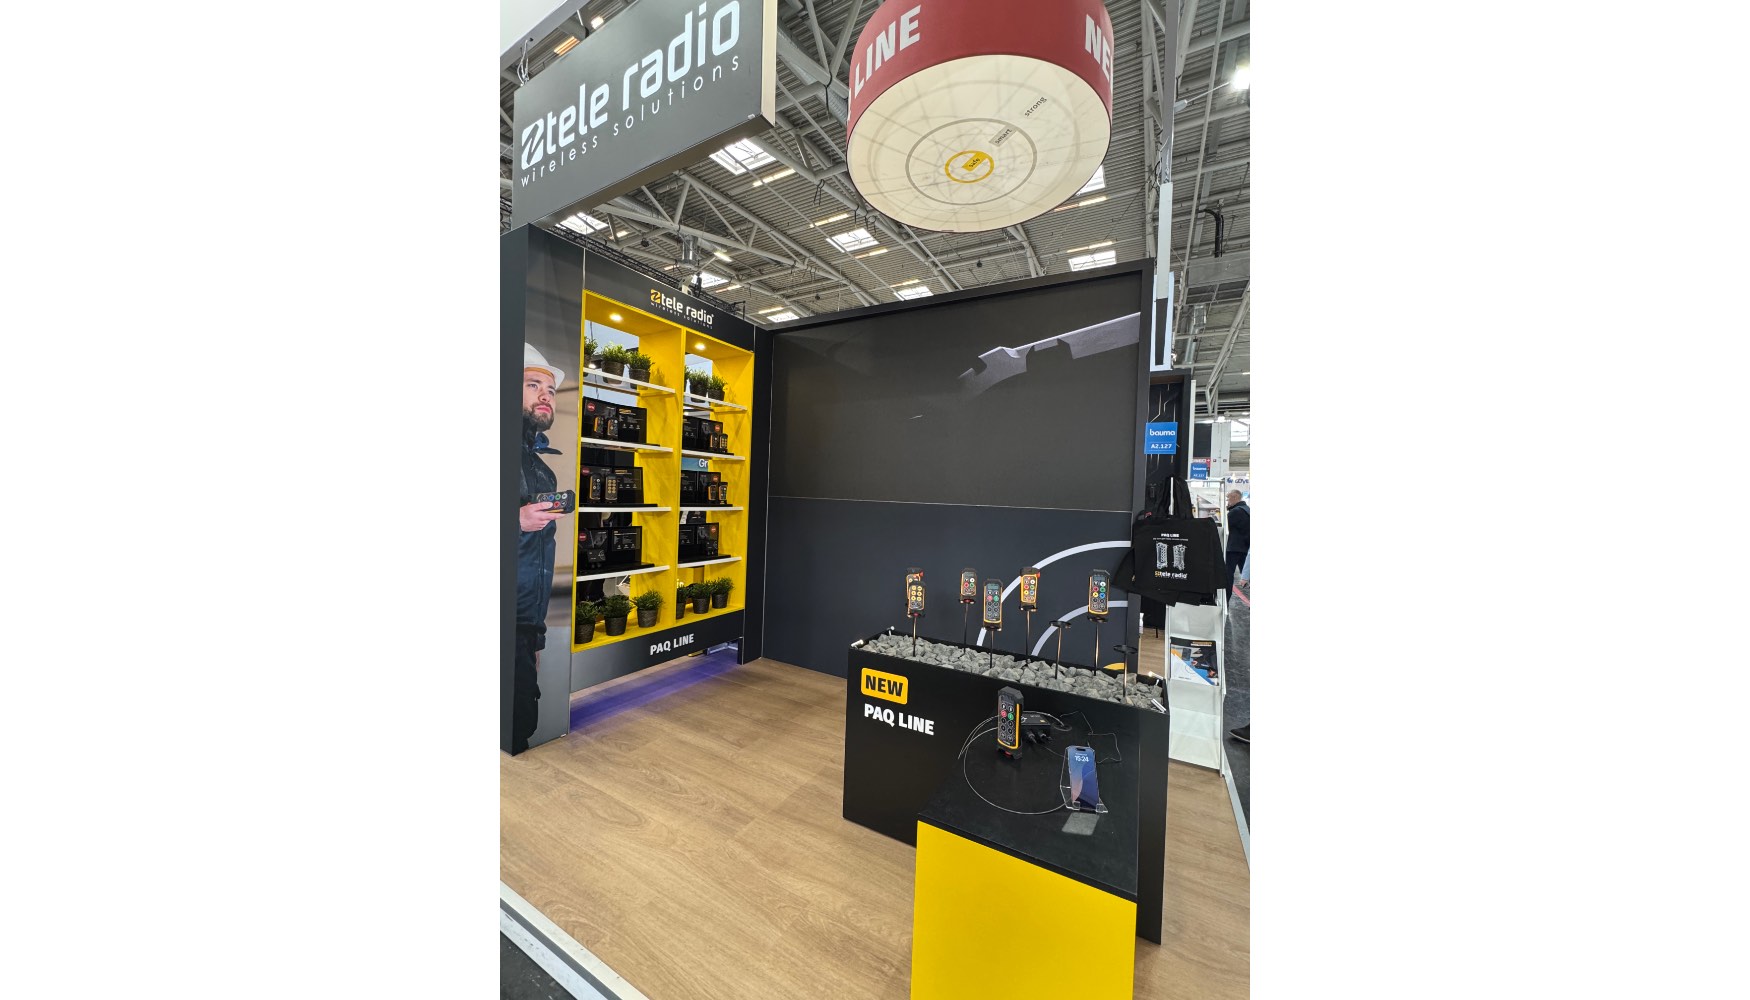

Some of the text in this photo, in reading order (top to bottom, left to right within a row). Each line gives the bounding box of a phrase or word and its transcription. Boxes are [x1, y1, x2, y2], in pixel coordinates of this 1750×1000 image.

[854, 4, 922, 100] LINE
[1084, 13, 1114, 96] NE
[546, 0, 740, 155] tele radio
[1024, 96, 1048, 117] strong
[521, 55, 739, 188] wireless solutions
[994, 128, 1013, 145] smart
[661, 293, 683, 313] tele
[1149, 428, 1176, 436] bauma
[650, 633, 695, 656] PAQ LINE
[865, 674, 904, 697] NEW
[864, 703, 935, 736] PAQ LINE
